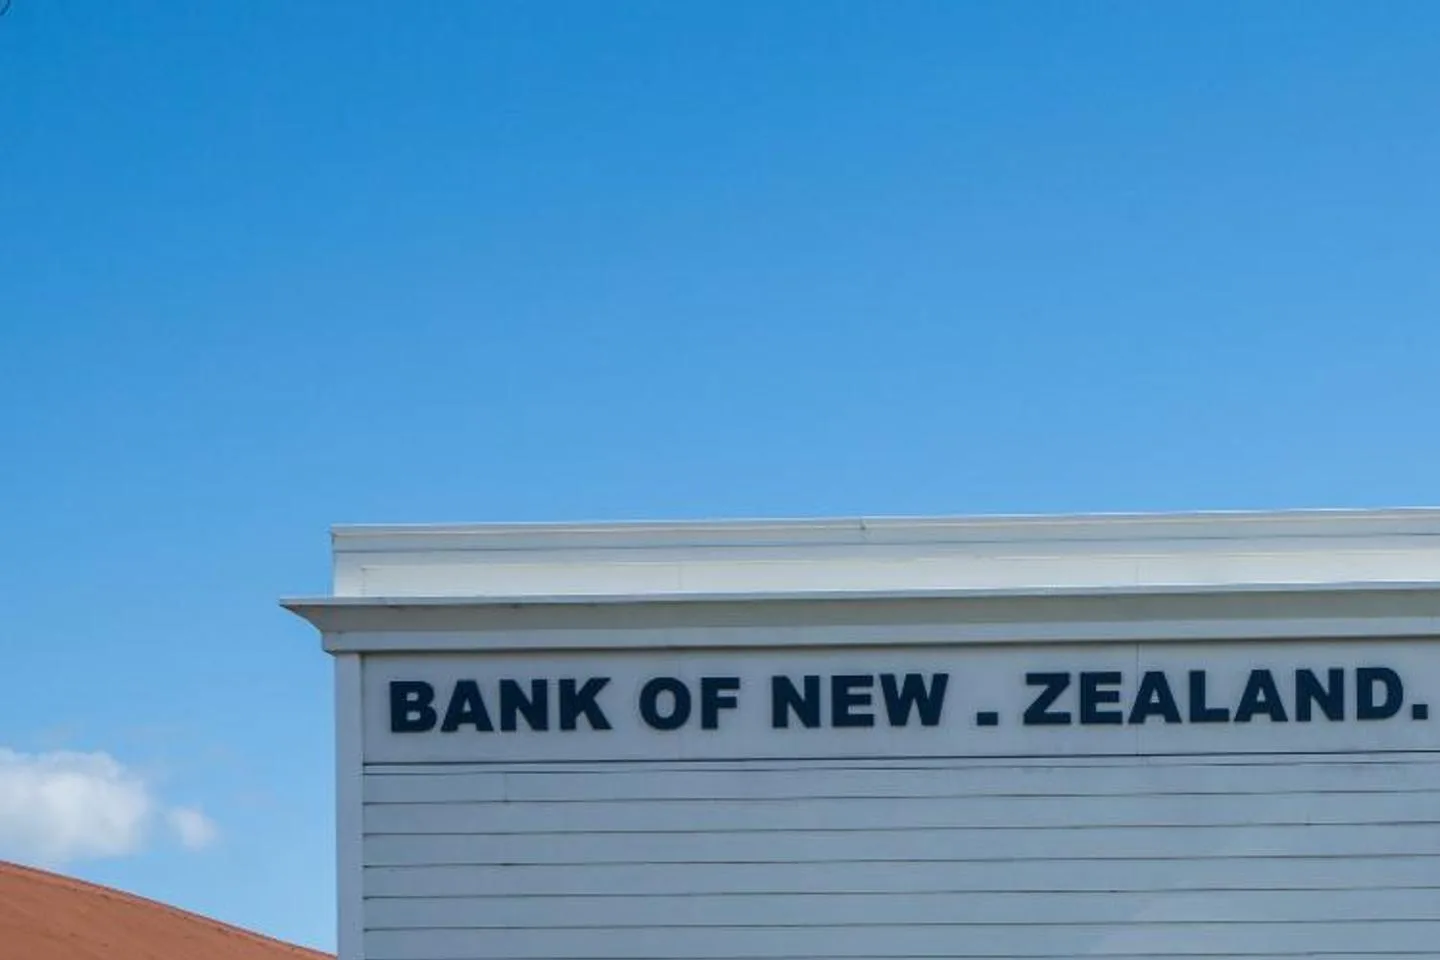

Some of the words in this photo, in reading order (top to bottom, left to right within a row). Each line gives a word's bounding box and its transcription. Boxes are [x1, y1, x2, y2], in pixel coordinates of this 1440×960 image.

[389, 677, 613, 734] BANK
[638, 676, 741, 732] OF
[771, 673, 949, 729] NEW
[1023, 667, 1429, 726] ZEALAND.
